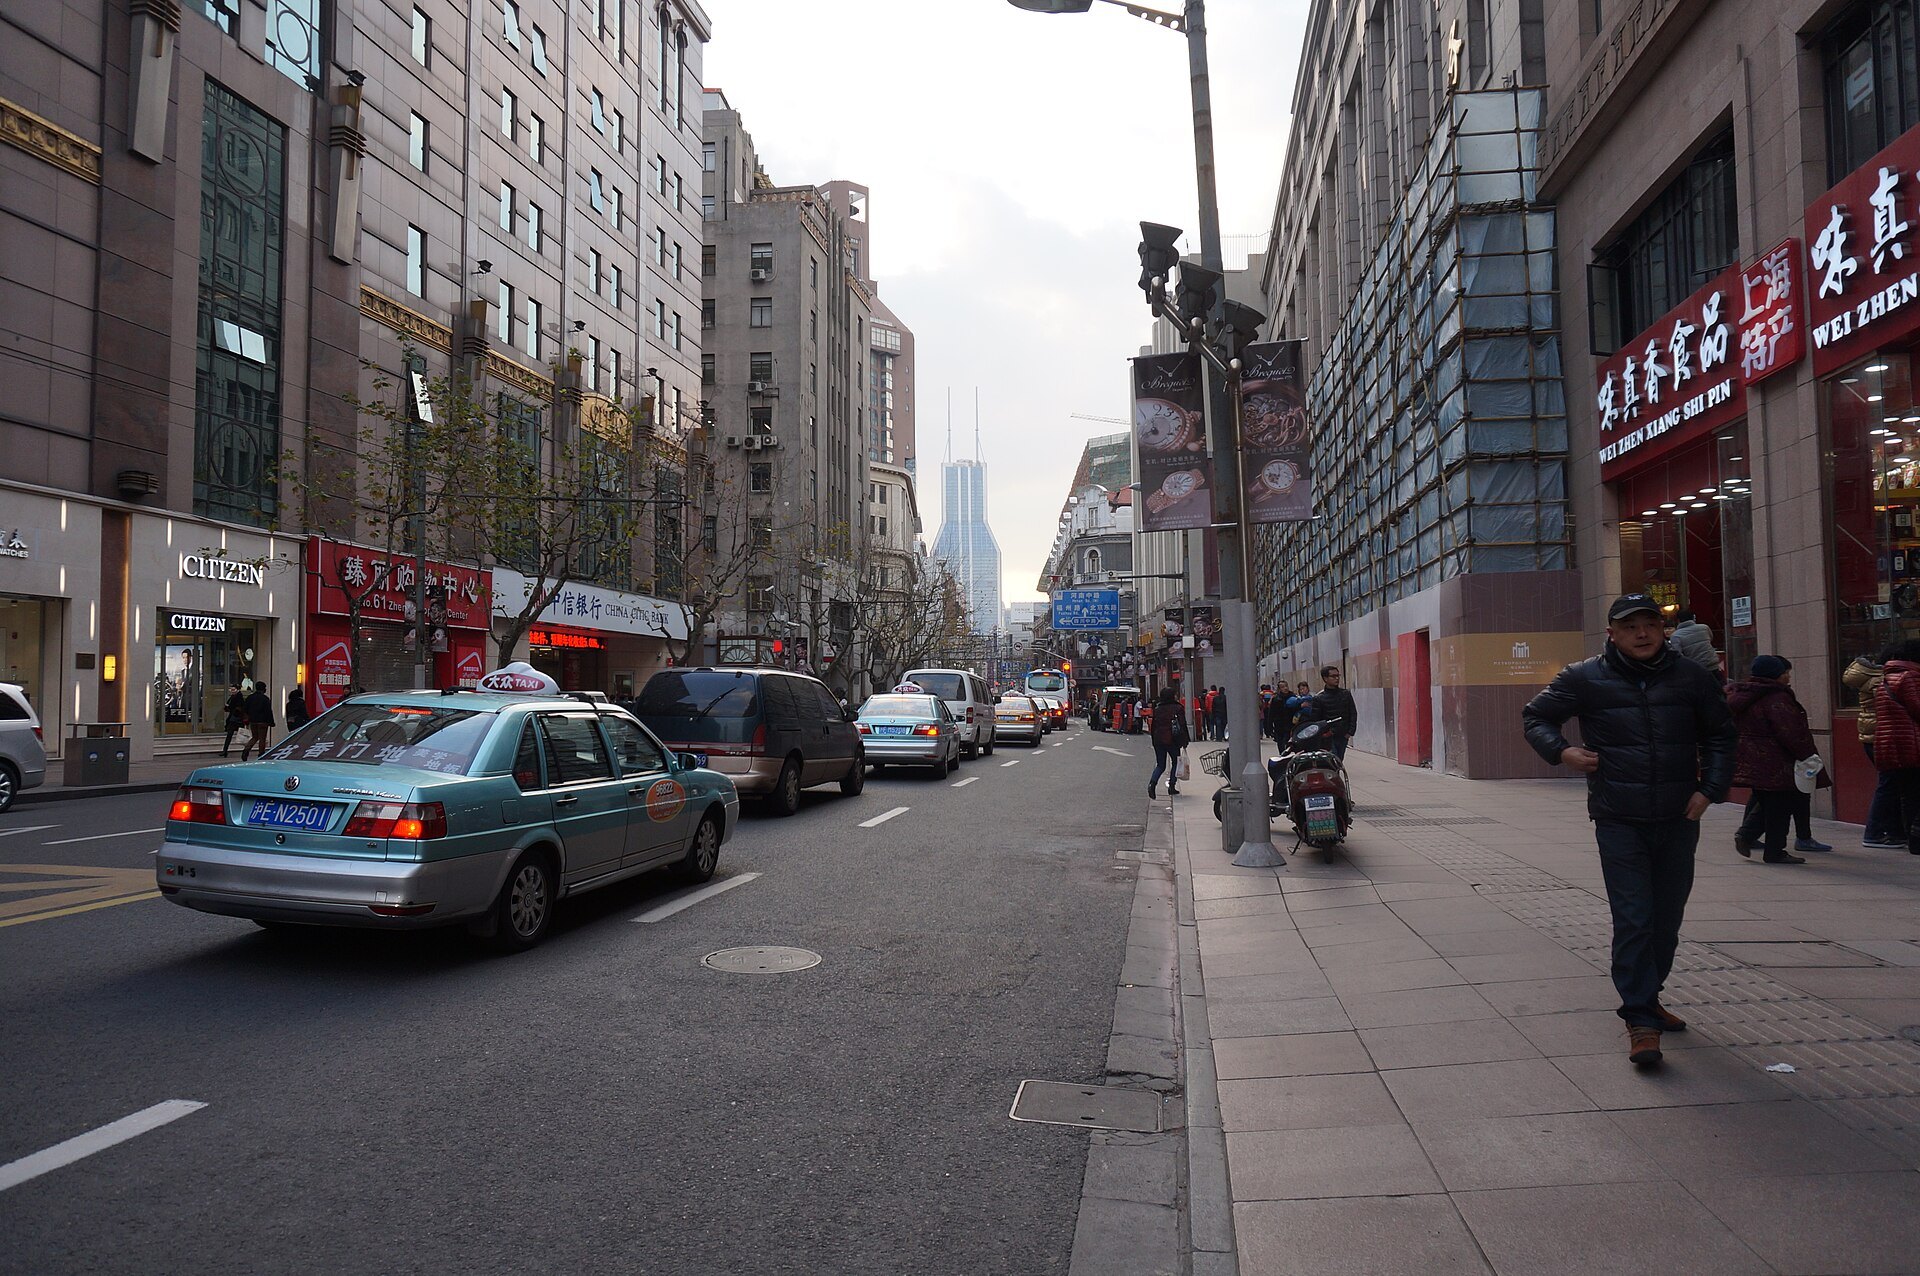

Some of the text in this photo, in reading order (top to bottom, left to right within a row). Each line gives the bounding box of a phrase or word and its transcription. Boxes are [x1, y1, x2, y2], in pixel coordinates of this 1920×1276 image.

[1811, 167, 1920, 299] 味真
[1739, 247, 1791, 325] 上海
[1813, 272, 1919, 349] WEI ZHEN
[1740, 304, 1793, 378] 特产
[1598, 291, 1728, 431] 味真香食品
[1599, 378, 1731, 464] WEI ZHEN XIANG SHI PIN
[183, 555, 264, 585] CITIZEN
[374, 594, 386, 610] 61
[447, 608, 468, 620] Center
[551, 590, 602, 621] 中信银行
[605, 603, 669, 624] CHINA CITIC BANK
[171, 613, 226, 632] CITIZEN
[488, 675, 514, 689] 大众
[515, 678, 539, 689] TAXI
[271, 741, 405, 762] 书香门地
[423, 759, 461, 774] 地板
[656, 782, 674, 797] 96822
